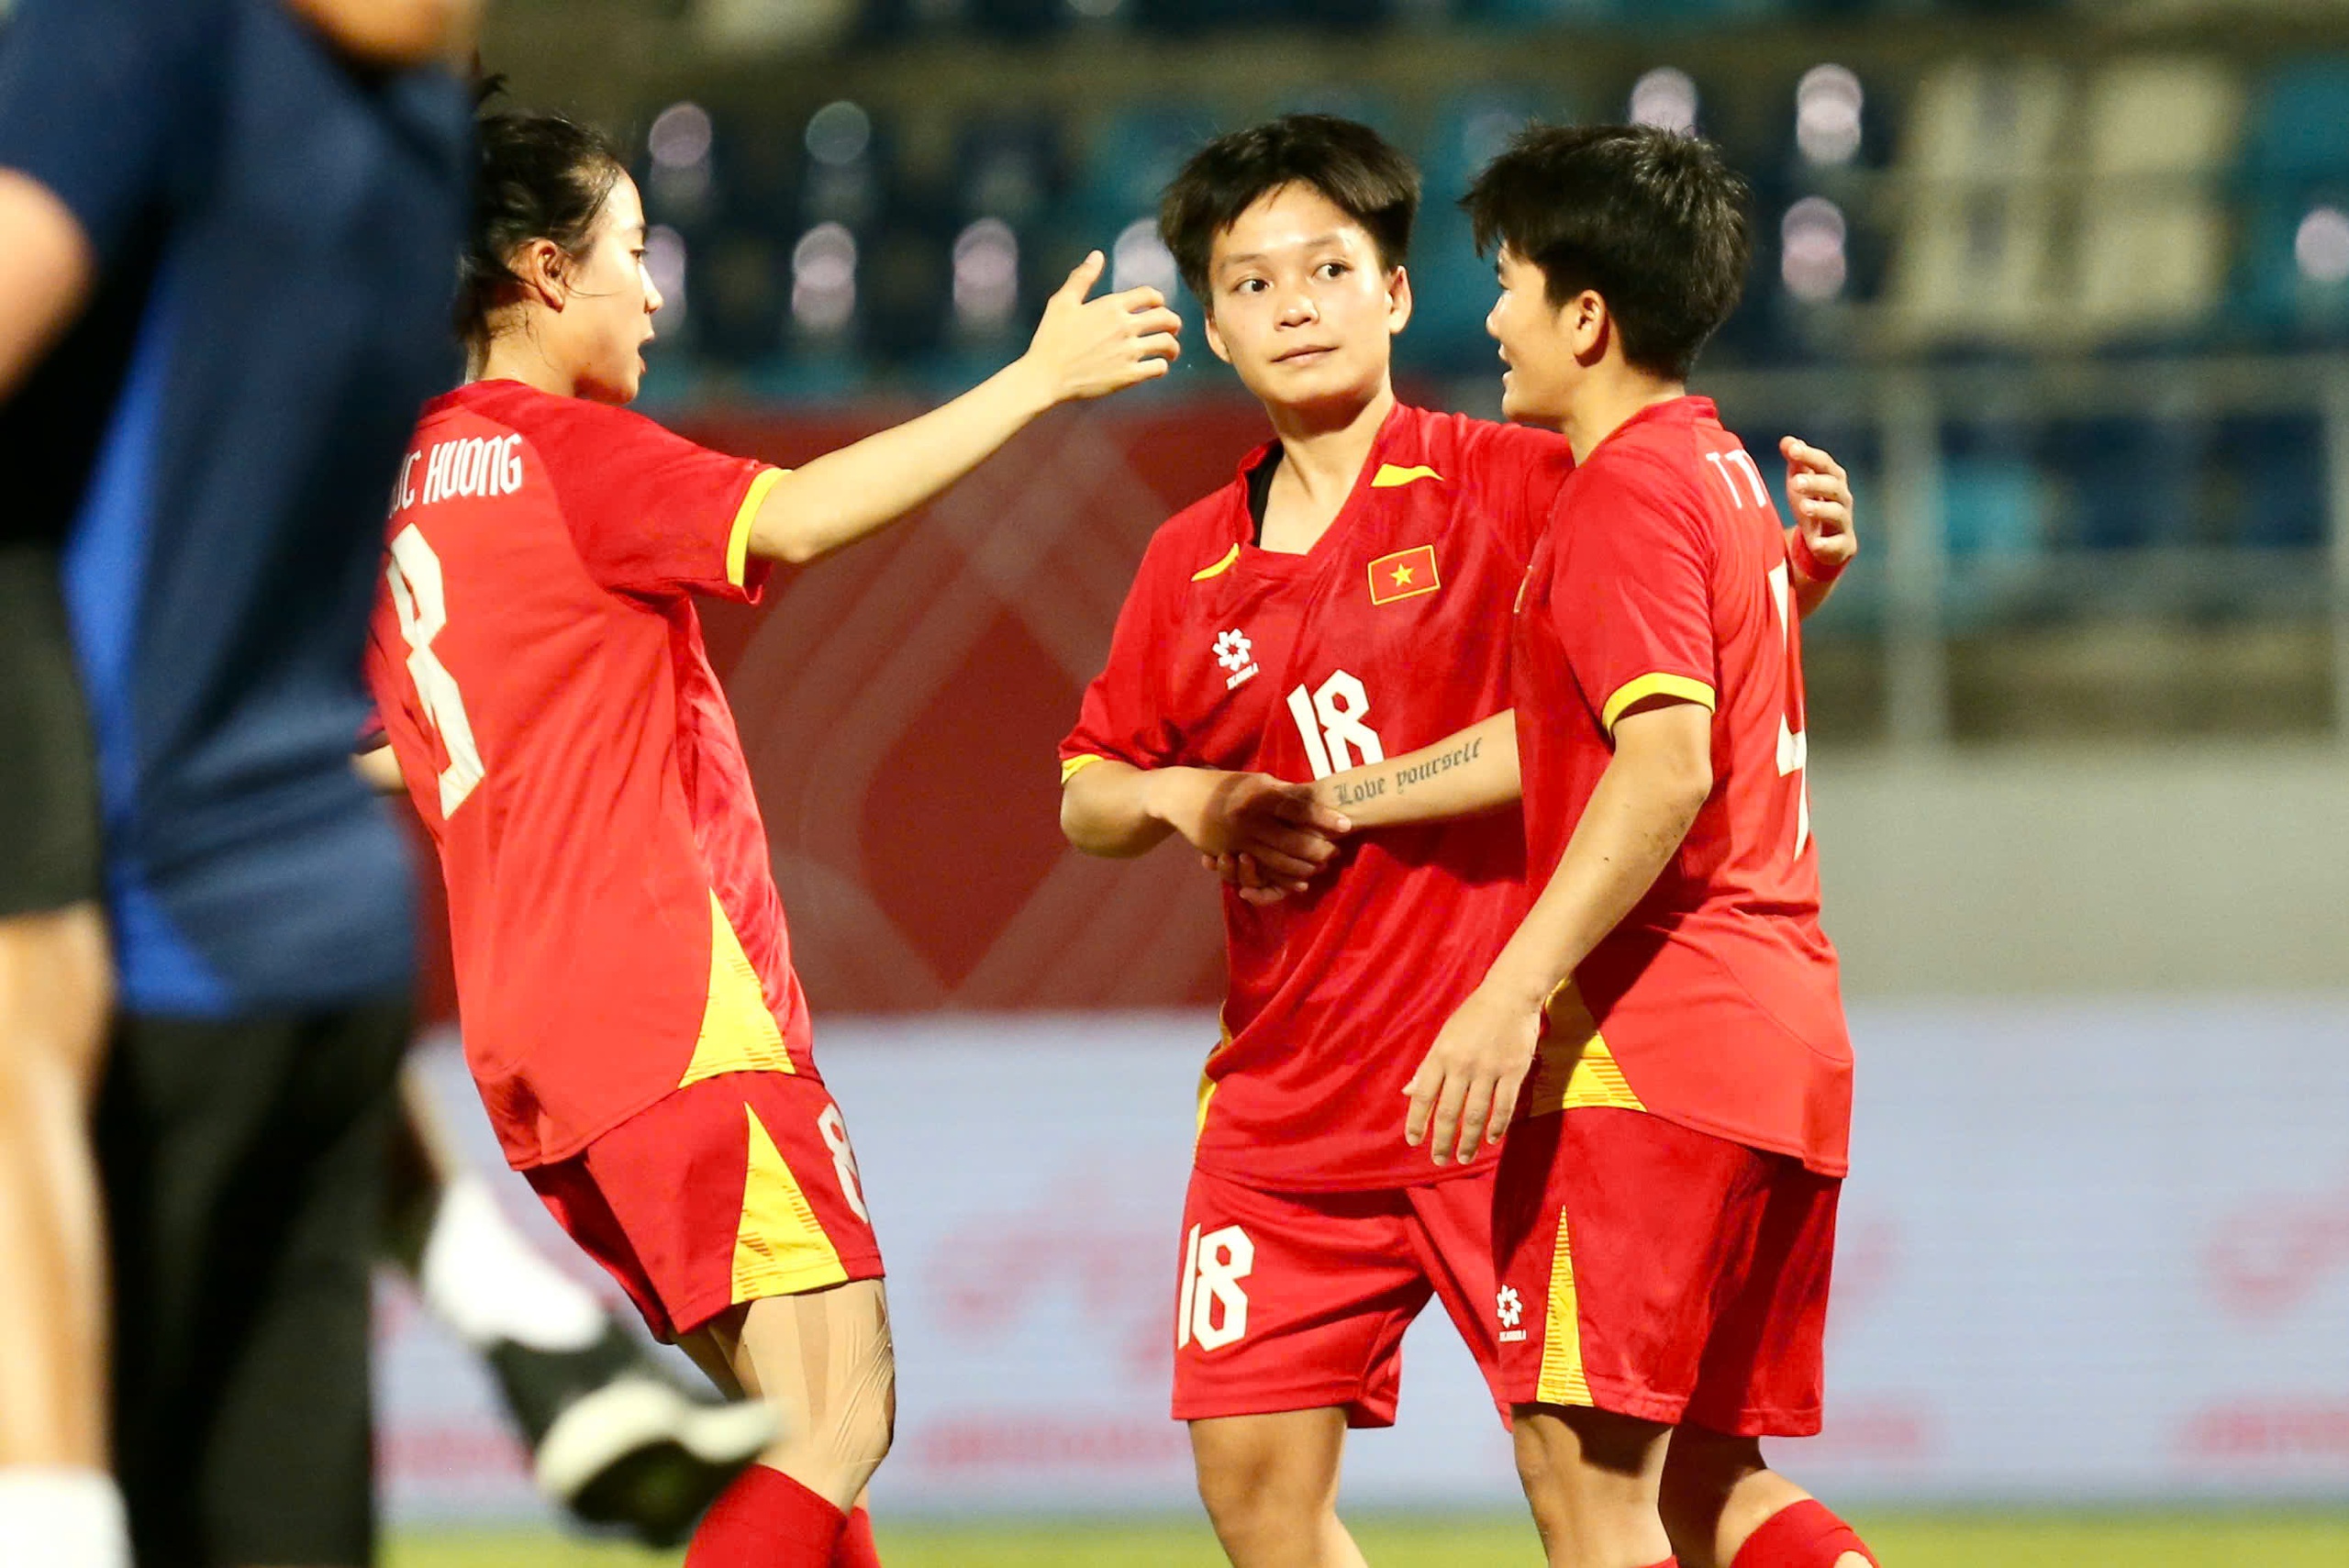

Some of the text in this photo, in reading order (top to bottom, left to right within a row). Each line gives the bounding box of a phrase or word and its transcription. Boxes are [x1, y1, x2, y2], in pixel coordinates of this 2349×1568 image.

[421, 432, 523, 505] HUONG
[385, 522, 486, 821] 8
[1286, 669, 1385, 781] 18
[1333, 737, 1483, 807] Love yourself
[817, 1103, 871, 1225] 8
[1178, 1222, 1255, 1351] 18
